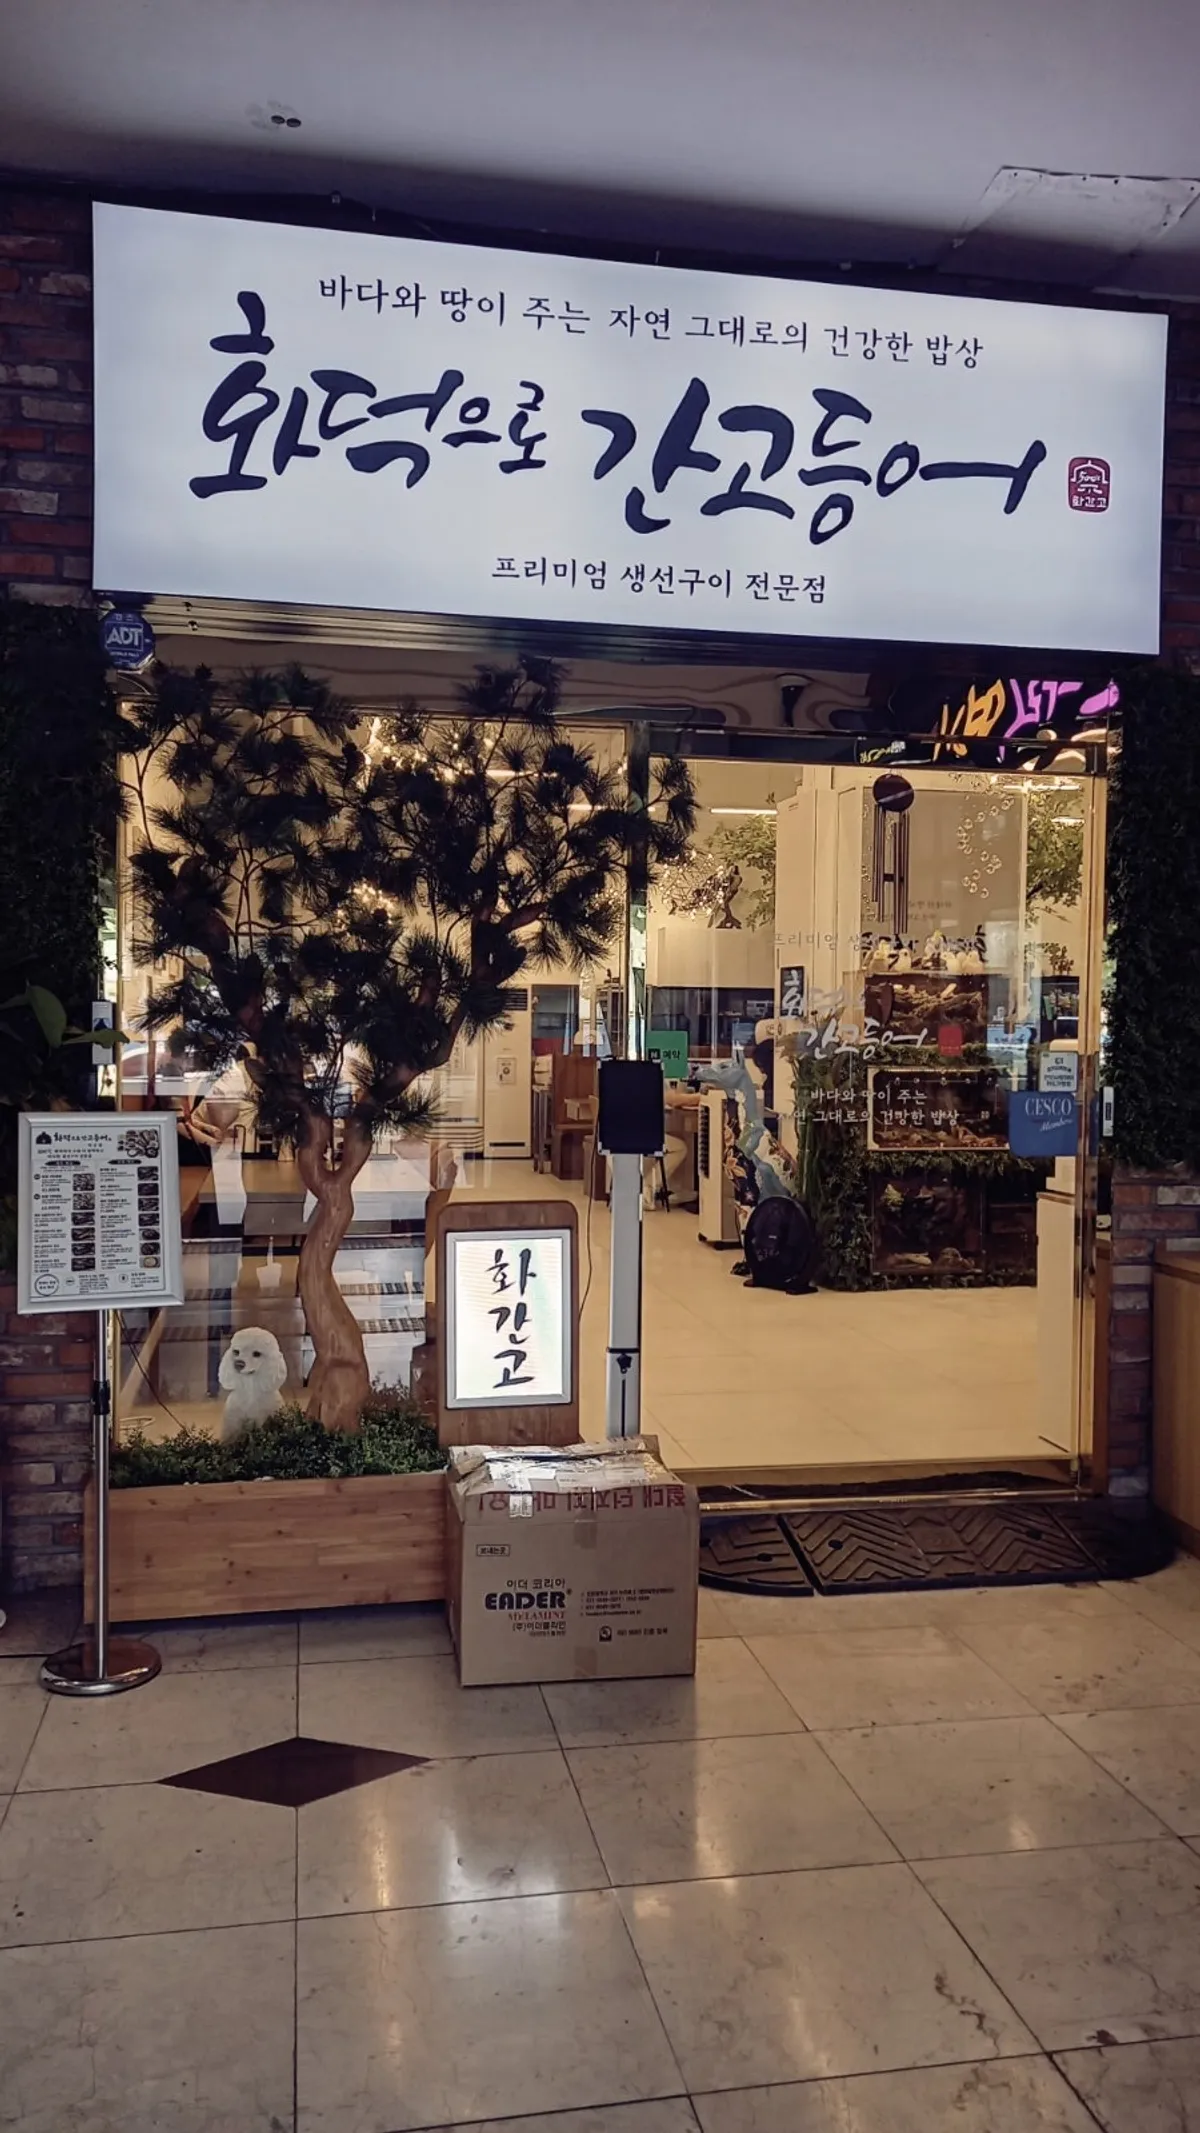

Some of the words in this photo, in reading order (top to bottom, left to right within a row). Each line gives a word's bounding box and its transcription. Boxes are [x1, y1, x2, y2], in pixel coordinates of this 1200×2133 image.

[320, 275, 427, 318] 바다와
[441, 288, 506, 326] 땅이
[523, 296, 591, 334] 주는
[608, 305, 671, 340] 자연
[685, 315, 808, 353] 그대로의
[824, 326, 913, 363] 건강한
[926, 335, 984, 369] 밥상
[188, 290, 547, 500] 화덕으로
[580, 377, 1048, 546] 간고등어
[491, 556, 607, 590] 프리미엄
[620, 563, 732, 599] 생선구이
[745, 571, 827, 604] 전문점
[106, 627, 143, 646] ADT
[810, 1087, 856, 1104] 바다와
[897, 1089, 928, 1106] 주는
[1025, 1098, 1073, 1117] CESCO
[484, 1248, 538, 1390] 화간고
[478, 1492, 557, 1512] 마요!
[532, 1577, 566, 1590] 코리아
[484, 1591, 566, 1611] EADER
